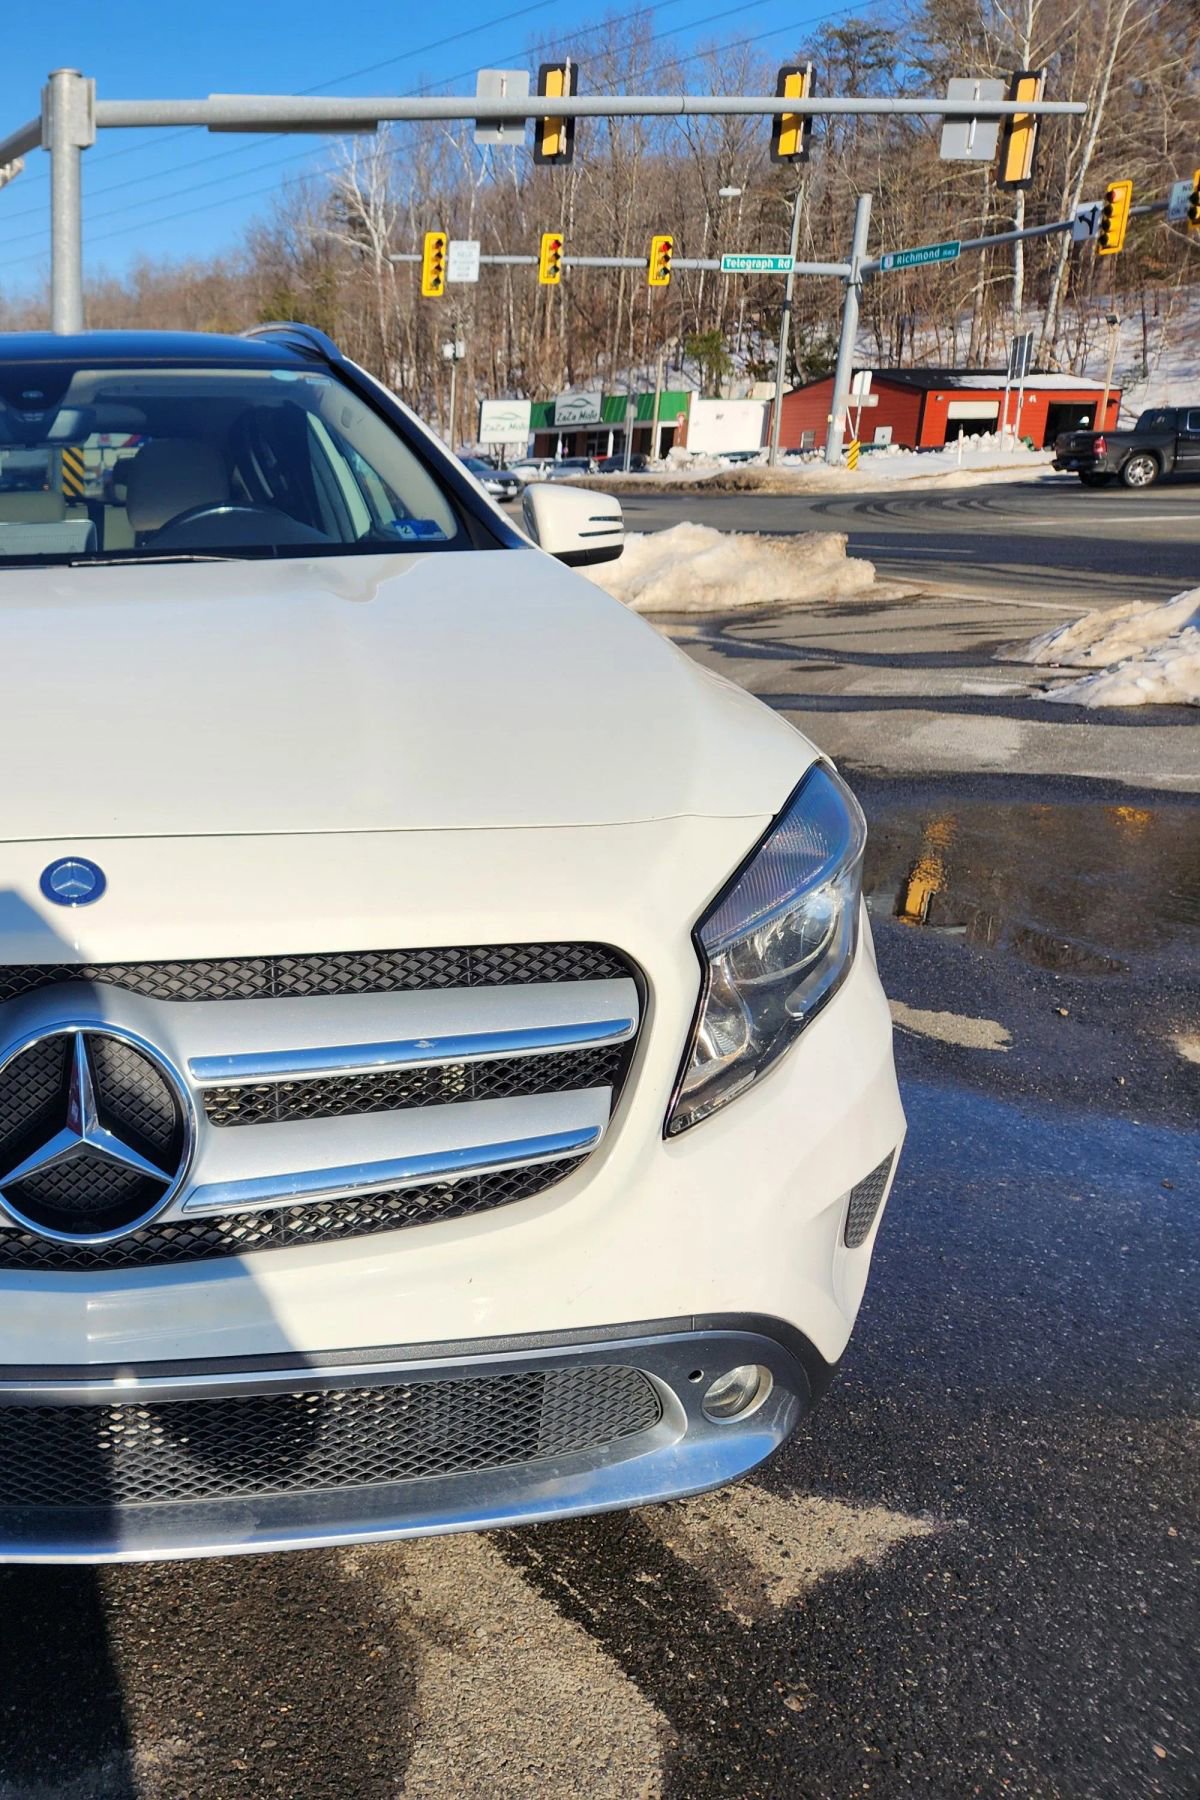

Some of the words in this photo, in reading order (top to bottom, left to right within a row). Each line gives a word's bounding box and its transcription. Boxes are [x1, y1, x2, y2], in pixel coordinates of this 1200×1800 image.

[896, 248, 941, 265] Richmond
[726, 258, 774, 270] Telegraph
[778, 258, 790, 269] Rd
